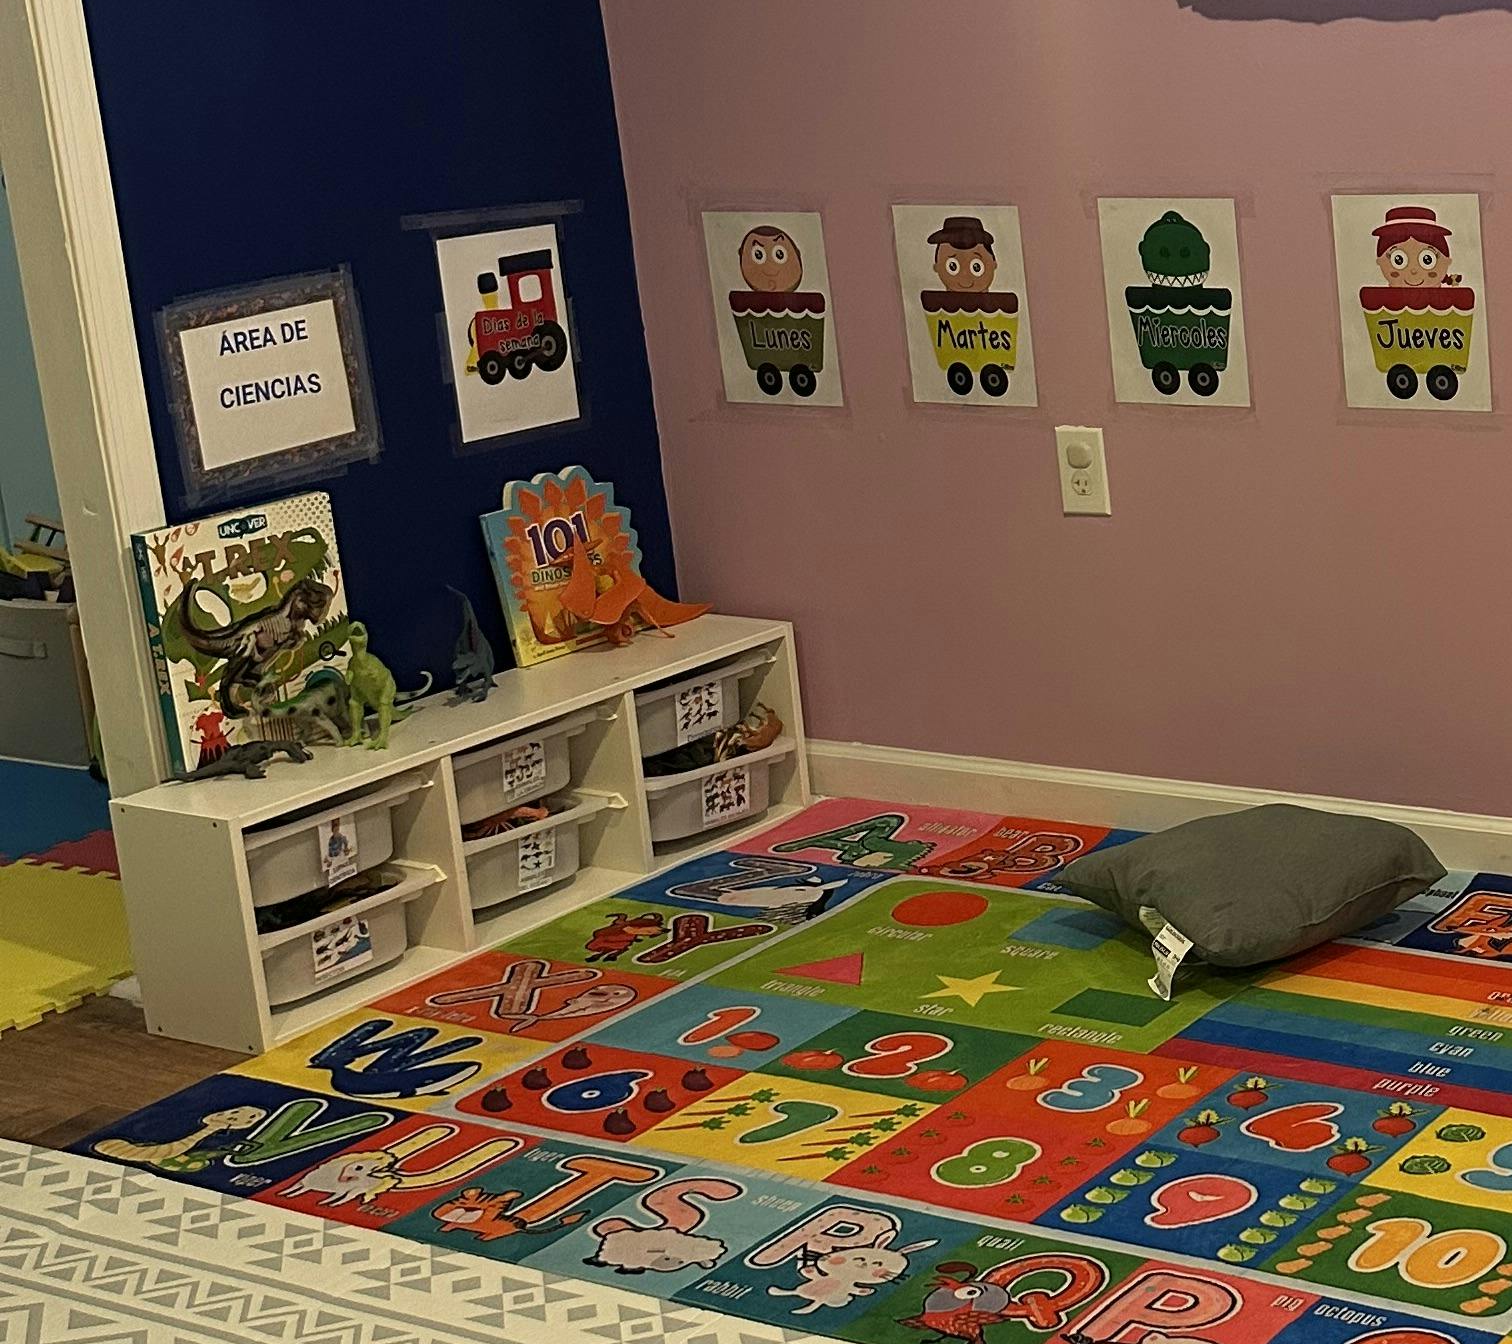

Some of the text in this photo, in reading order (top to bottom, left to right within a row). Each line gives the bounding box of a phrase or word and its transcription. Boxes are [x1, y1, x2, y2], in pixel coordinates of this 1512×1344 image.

[219, 319, 308, 356] ÁREA DE
[499, 334, 540, 353] semana
[516, 313, 529, 329] de
[750, 325, 812, 352] Lunes
[937, 320, 1011, 351] Martes
[1137, 316, 1228, 351] Miercoles
[1376, 320, 1464, 350] Jueves
[220, 372, 321, 409] CIENCIAS
[525, 511, 590, 568] 101
[771, 813, 908, 867] A
[632, 912, 777, 965] Y
[425, 960, 602, 1019] X
[759, 979, 826, 999] triangle
[913, 1001, 954, 1018] star
[307, 1018, 484, 1076] W
[841, 1031, 955, 1078] 2
[1037, 1022, 1124, 1046] rectangle
[1428, 1038, 1475, 1058] cyan
[1448, 1023, 1504, 1042] green
[541, 1069, 654, 1114] 6
[1036, 1063, 1144, 1114] 3
[1372, 1076, 1441, 1098] purple
[1408, 1060, 1453, 1079] blue
[223, 1098, 394, 1167] V
[734, 1099, 842, 1146] 7
[1240, 1102, 1345, 1152] 4
[385, 1124, 525, 1190] U
[930, 1136, 1043, 1189] 8
[519, 1154, 668, 1227] T
[590, 1177, 749, 1239] S
[1143, 1173, 1259, 1229] 9
[745, 1203, 902, 1269] R
[977, 1232, 1026, 1252] quail
[1347, 1216, 1508, 1291] 10
[697, 1276, 754, 1301] rabbit
[990, 1251, 1110, 1330] Q
[1061, 1265, 1243, 1344] P
[1270, 1291, 1302, 1311] pig
[1314, 1301, 1387, 1327] octopus
